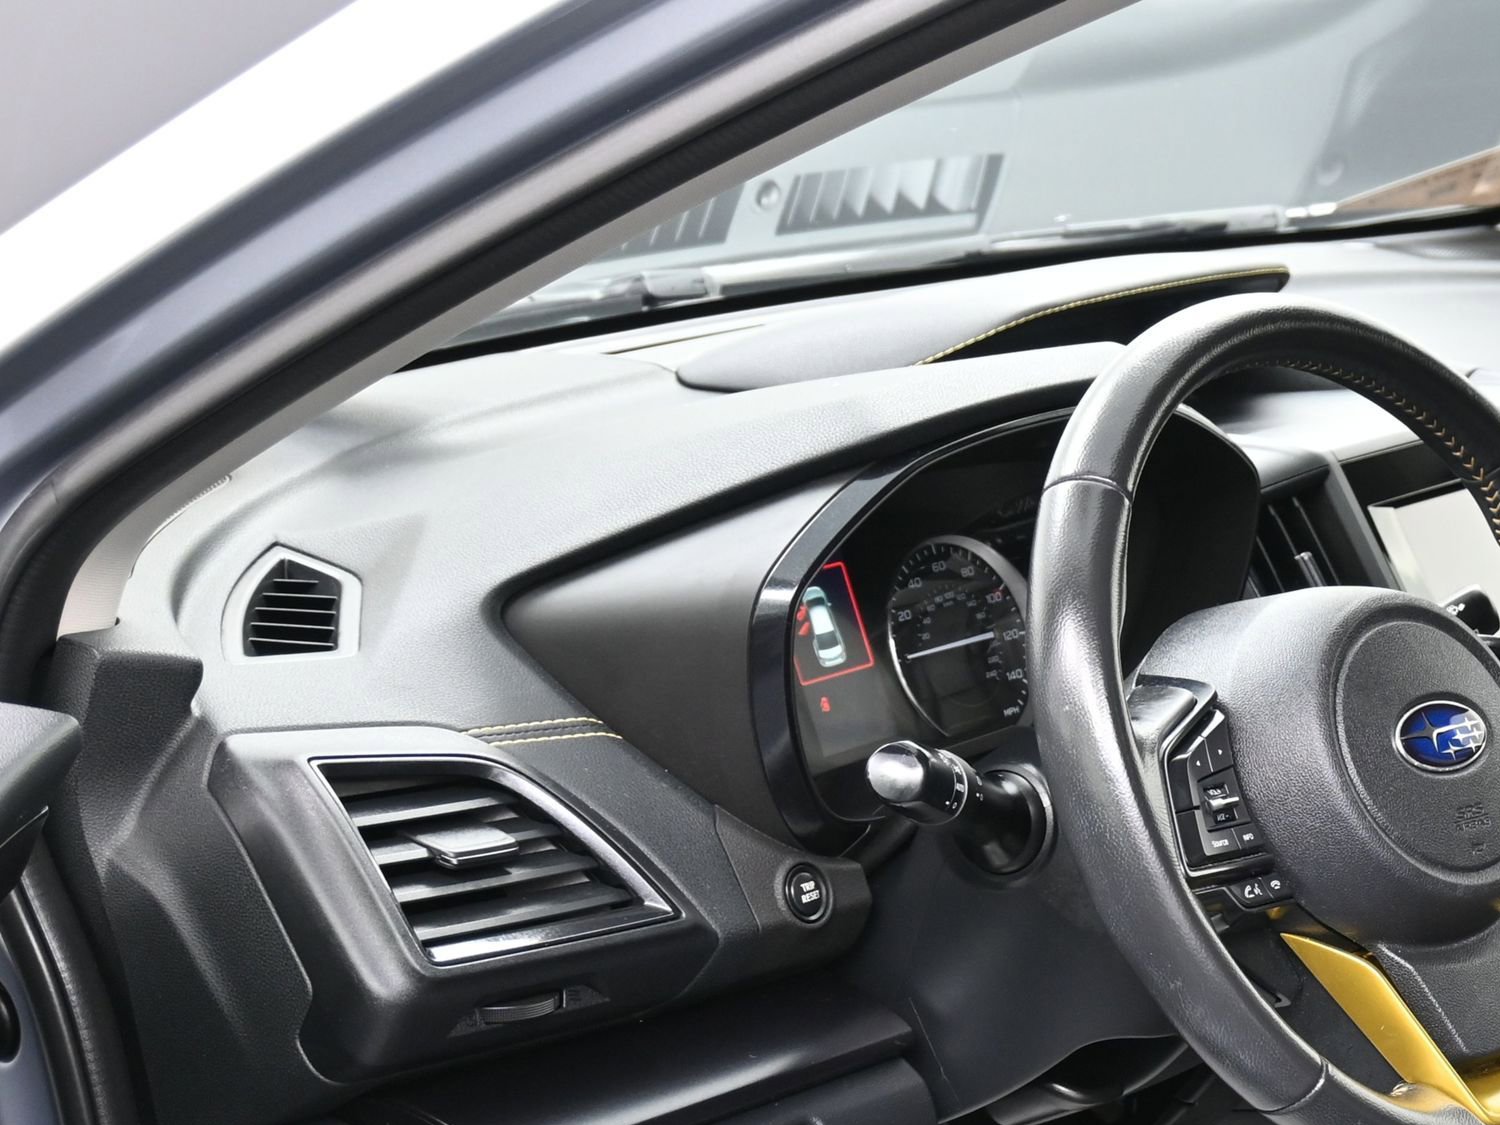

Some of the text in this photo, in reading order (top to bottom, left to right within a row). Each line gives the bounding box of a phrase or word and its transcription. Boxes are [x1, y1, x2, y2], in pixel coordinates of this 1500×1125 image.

[932, 561, 946, 572] 60
[960, 566, 975, 578] 80
[908, 577, 922, 589] 40
[985, 592, 1002, 604] 100
[897, 610, 912, 621] 20
[1003, 629, 1019, 641] 120
[1006, 669, 1023, 680] 140
[1003, 706, 1020, 717] MPH
[800, 880, 816, 892] TRIP
[801, 889, 821, 904] RESET
